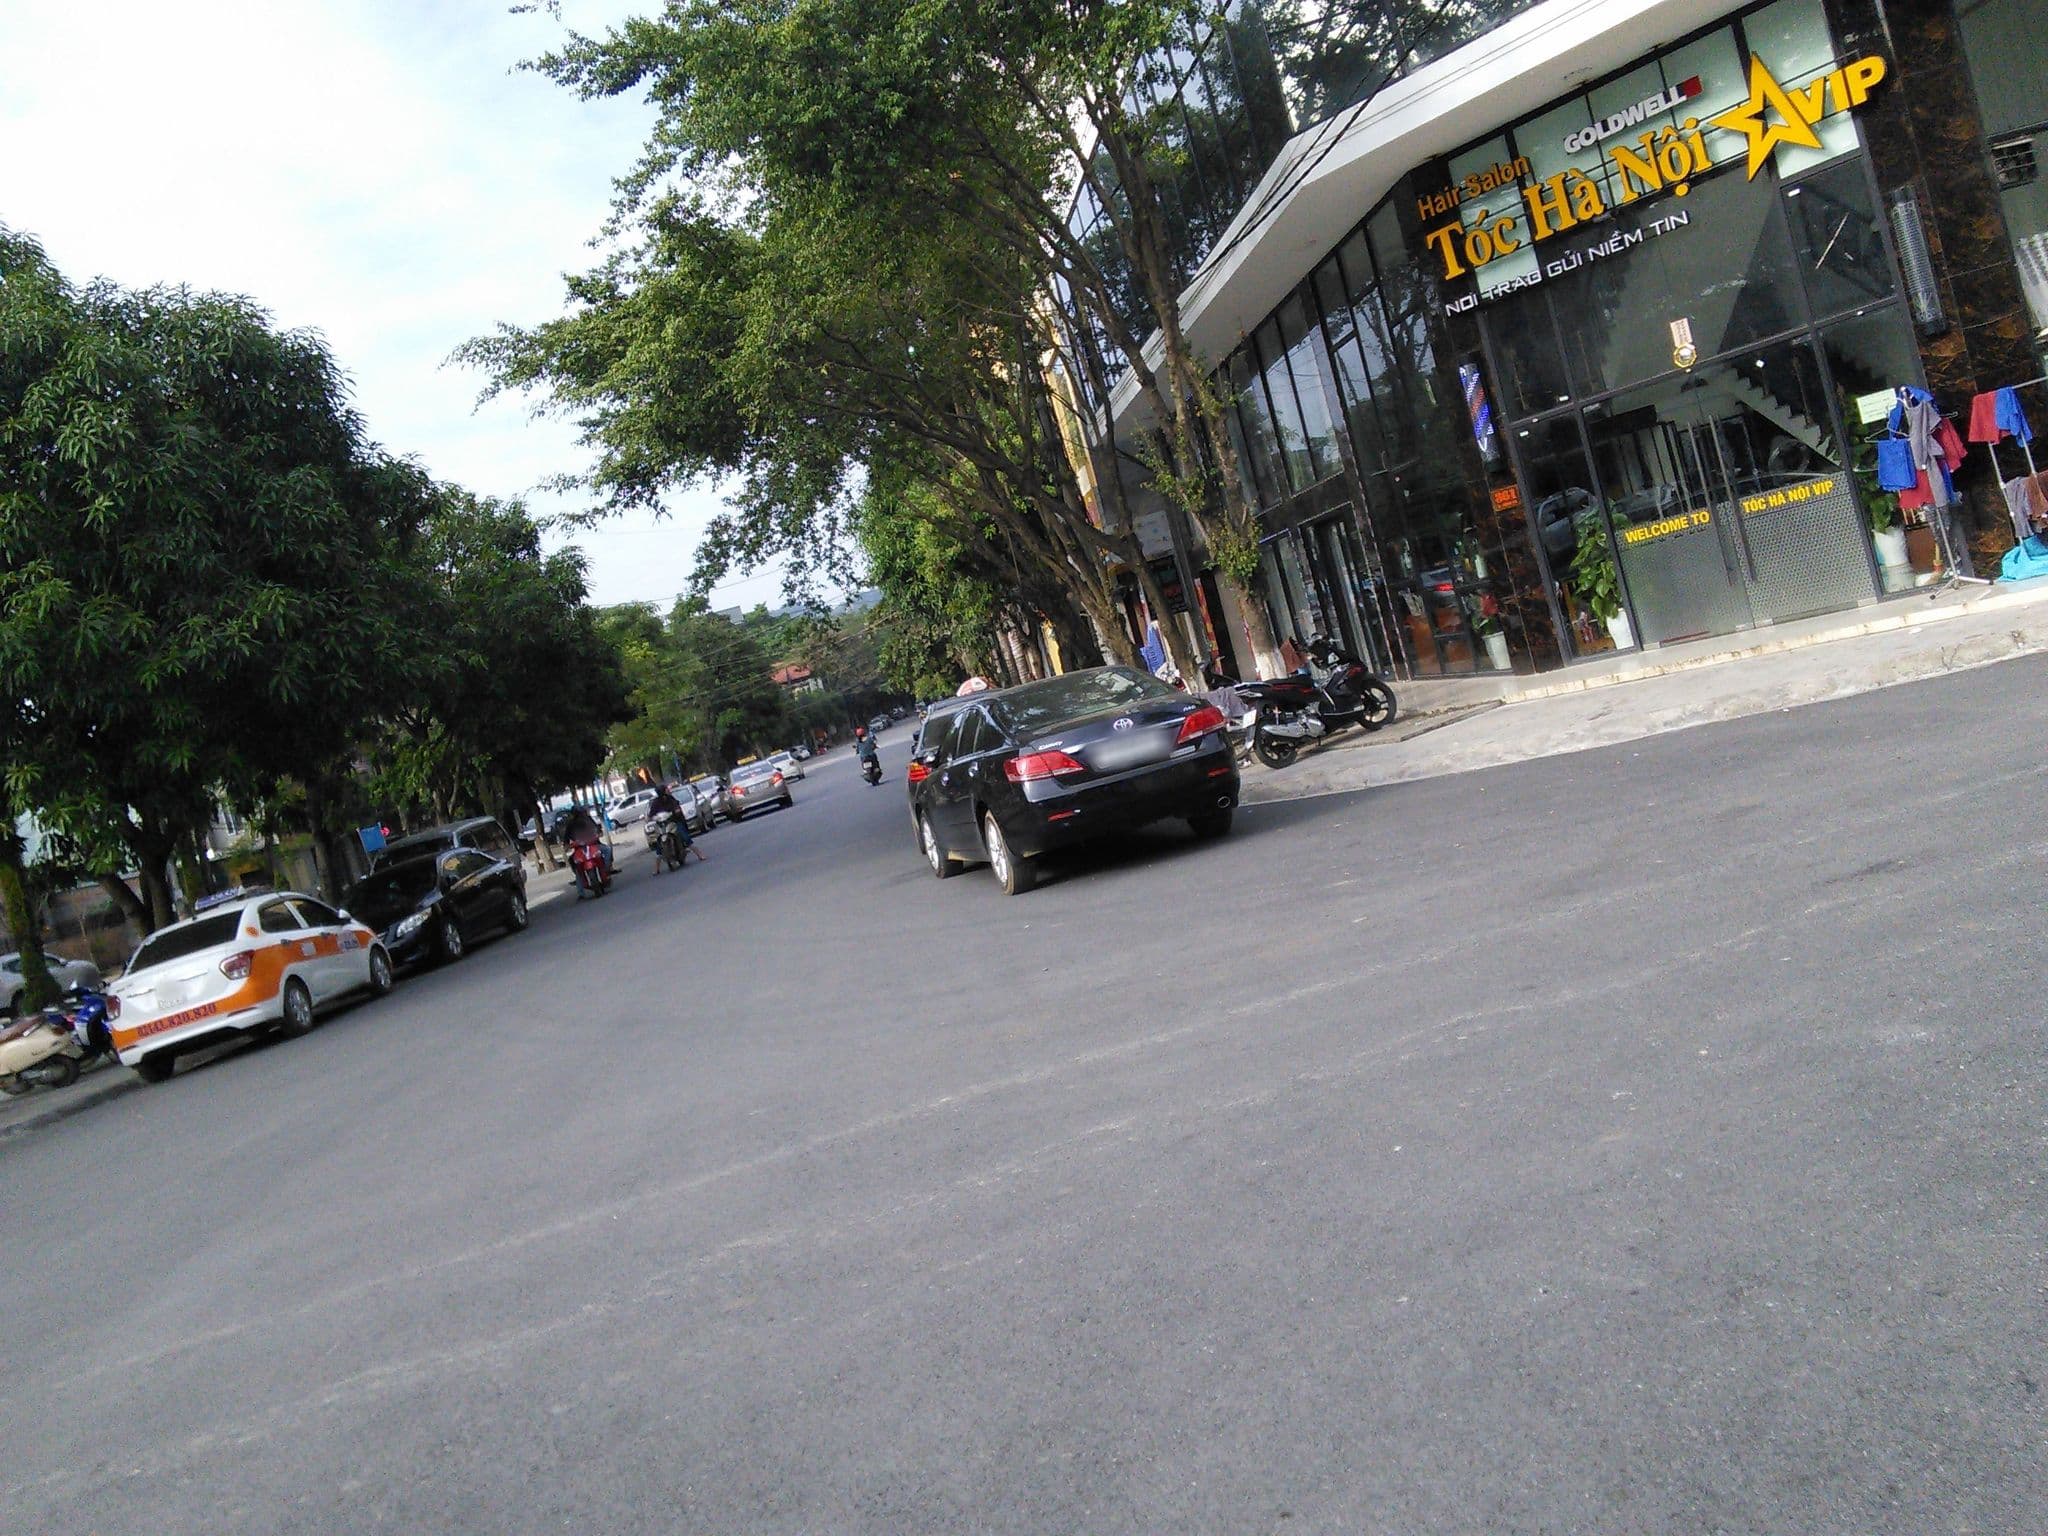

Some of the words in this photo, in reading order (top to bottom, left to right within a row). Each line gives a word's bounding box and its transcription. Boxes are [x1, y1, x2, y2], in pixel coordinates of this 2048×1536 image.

[1564, 86, 1687, 153] GOLDWELL
[1417, 186, 1461, 220] Hair
[1465, 155, 1530, 198] Salon
[1426, 209, 1518, 280] Tóc
[1523, 167, 1604, 241] Hà
[1609, 117, 1712, 198] Nội
[1786, 55, 1887, 126] VIP
[1649, 210, 1688, 236] TIN
[1812, 480, 1833, 496] VIP
[1625, 516, 1689, 543] WELCOME
[1690, 511, 1710, 526] TO
